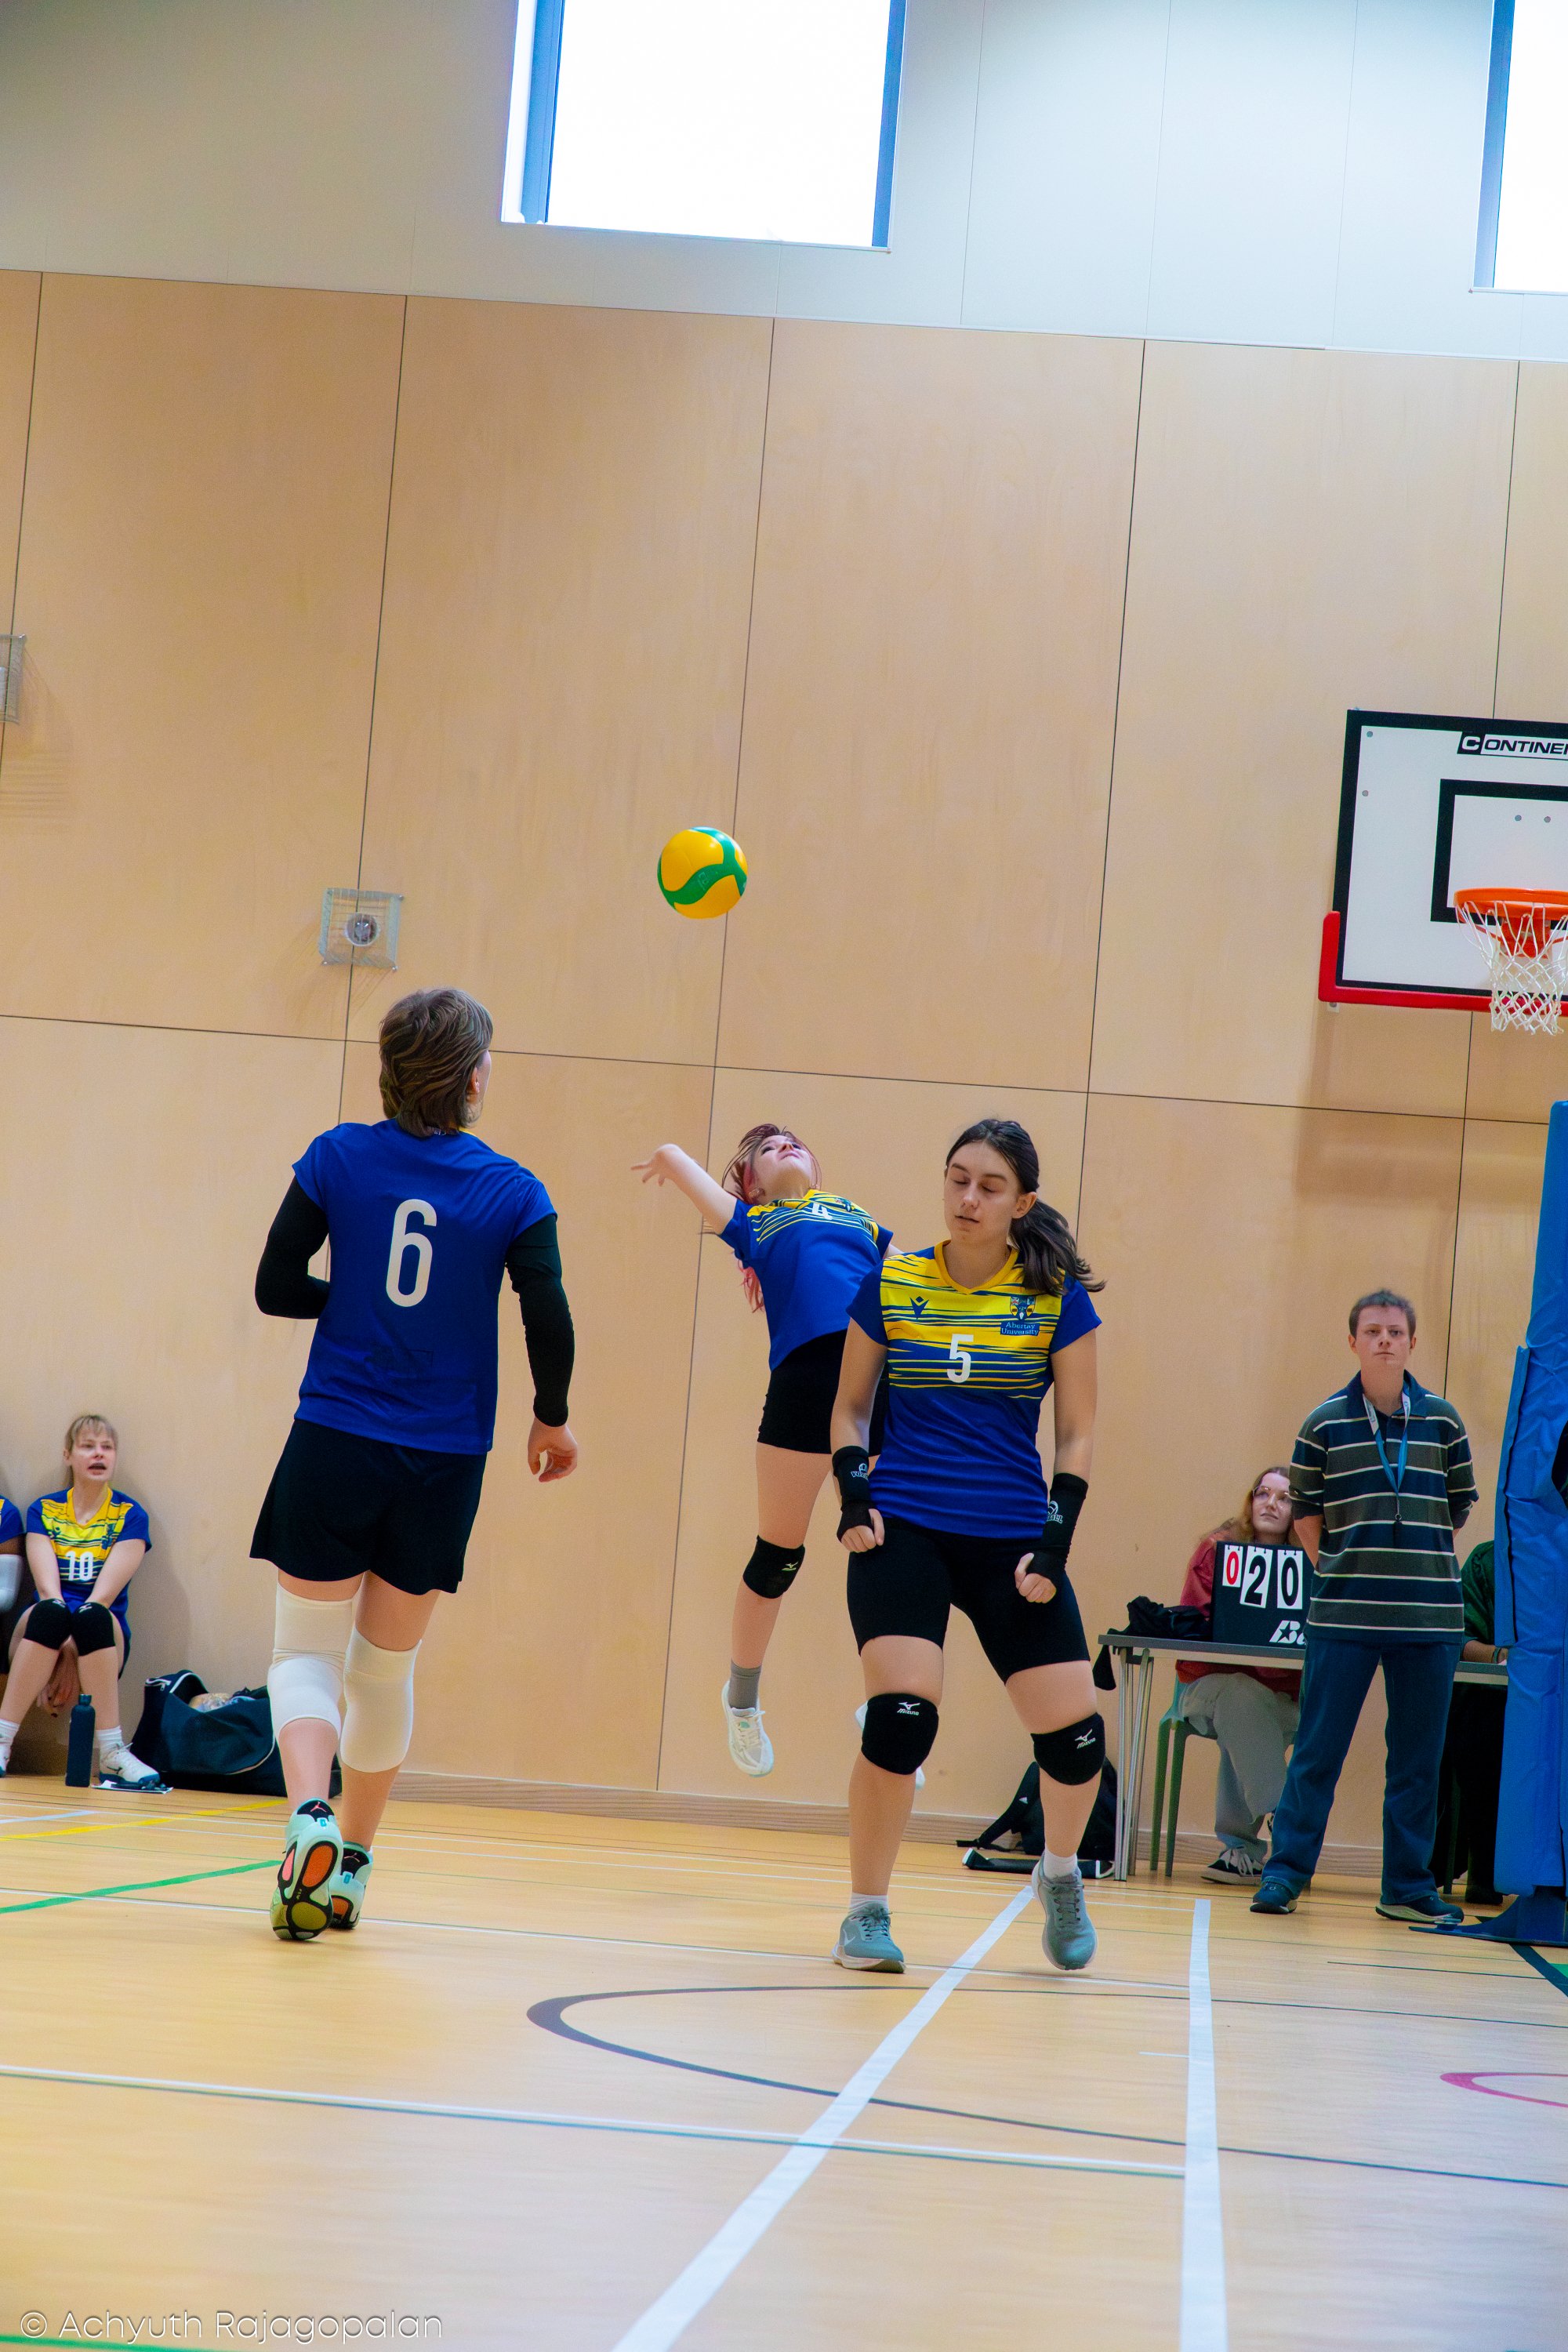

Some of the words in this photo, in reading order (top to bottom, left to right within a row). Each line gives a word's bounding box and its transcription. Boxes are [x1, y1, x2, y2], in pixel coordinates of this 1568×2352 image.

[812, 1202, 833, 1220] 4
[386, 1199, 437, 1307] 6
[946, 1334, 974, 1383] 5
[65, 1551, 93, 1581] 10
